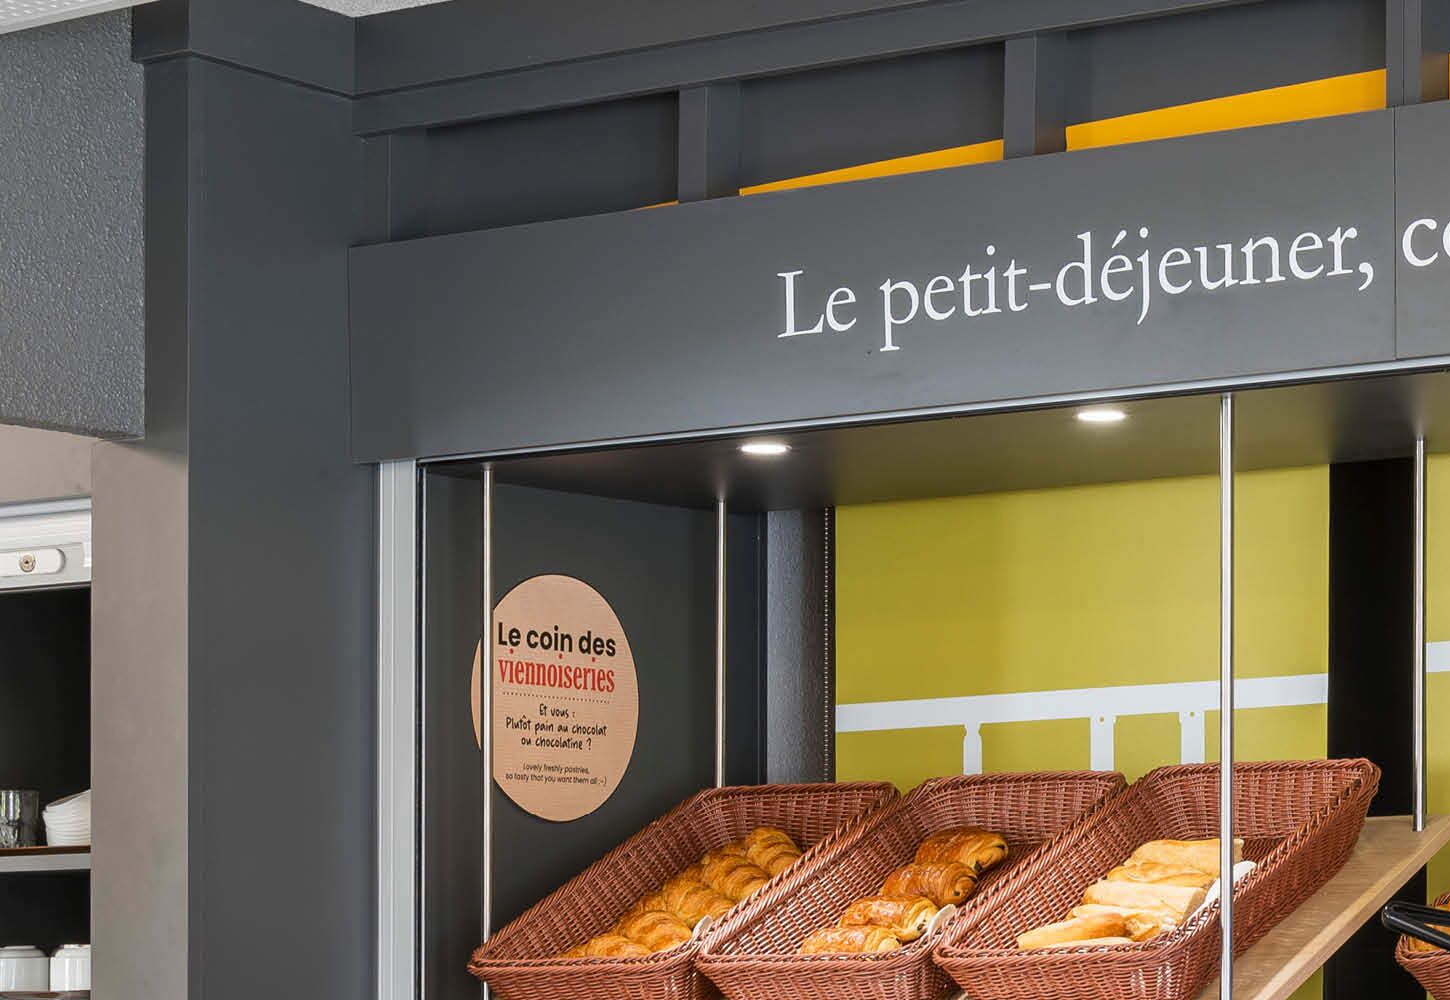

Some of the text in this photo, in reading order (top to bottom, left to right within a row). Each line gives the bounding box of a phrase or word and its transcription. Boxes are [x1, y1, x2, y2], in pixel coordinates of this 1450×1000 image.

[776, 270, 857, 338] Le
[878, 225, 1376, 353] petit-déjeuner,
[497, 622, 617, 657] Le coin des
[498, 648, 616, 693] viennoiseries
[539, 703, 547, 717] Et
[551, 707, 570, 719] vous
[505, 714, 608, 737] Plutôt pain au chocolat
[521, 736, 532, 746] ou
[535, 736, 583, 751] chocolatine
[544, 775, 557, 784] you
